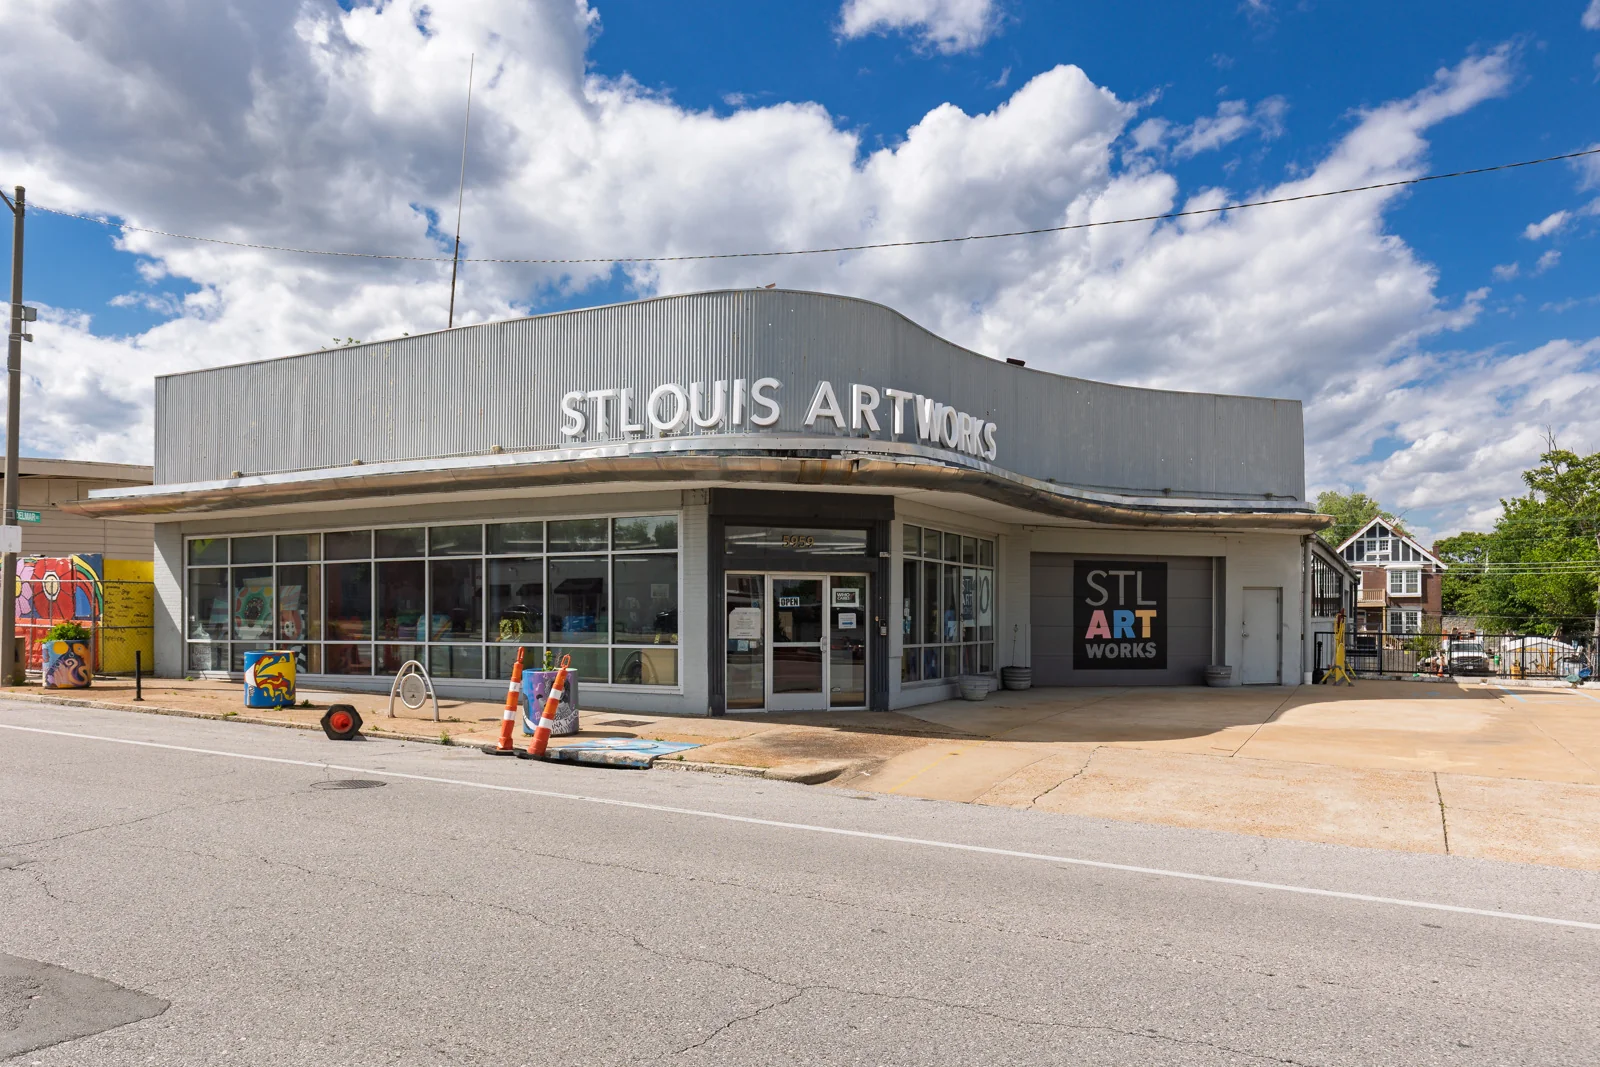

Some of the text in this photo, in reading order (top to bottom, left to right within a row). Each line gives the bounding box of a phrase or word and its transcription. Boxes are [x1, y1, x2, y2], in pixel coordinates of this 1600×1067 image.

[782, 535, 815, 548] 5959
[1085, 570, 1157, 606] STL
[780, 598, 799, 606] OPEN
[1085, 609, 1157, 639] ART
[1085, 642, 1157, 659] WORKS
